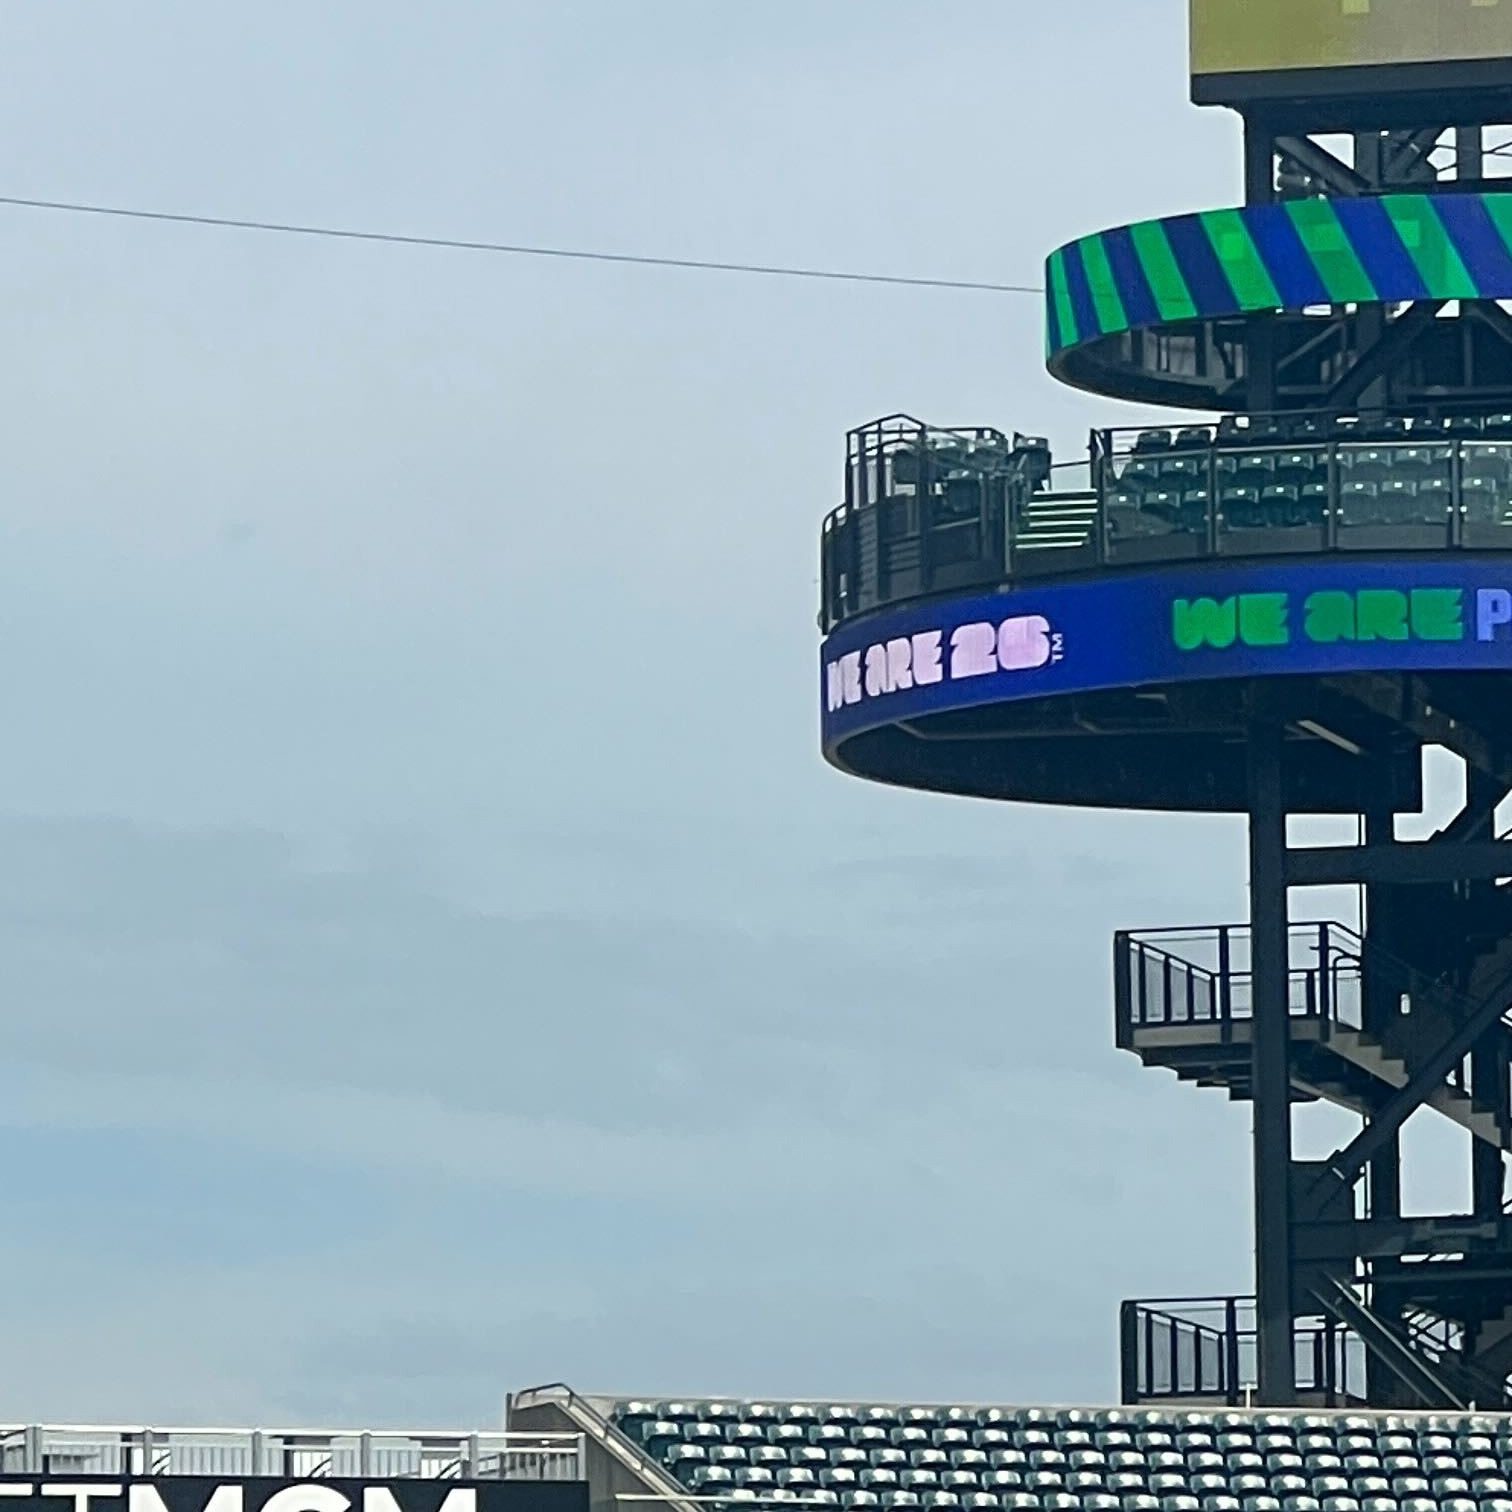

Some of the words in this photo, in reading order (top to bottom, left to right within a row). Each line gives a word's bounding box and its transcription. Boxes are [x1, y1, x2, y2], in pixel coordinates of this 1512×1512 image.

[1172, 592, 1289, 650] WE
[1304, 588, 1463, 643] ARE
[864, 629, 944, 697] ARE
[950, 615, 1050, 679] 26
